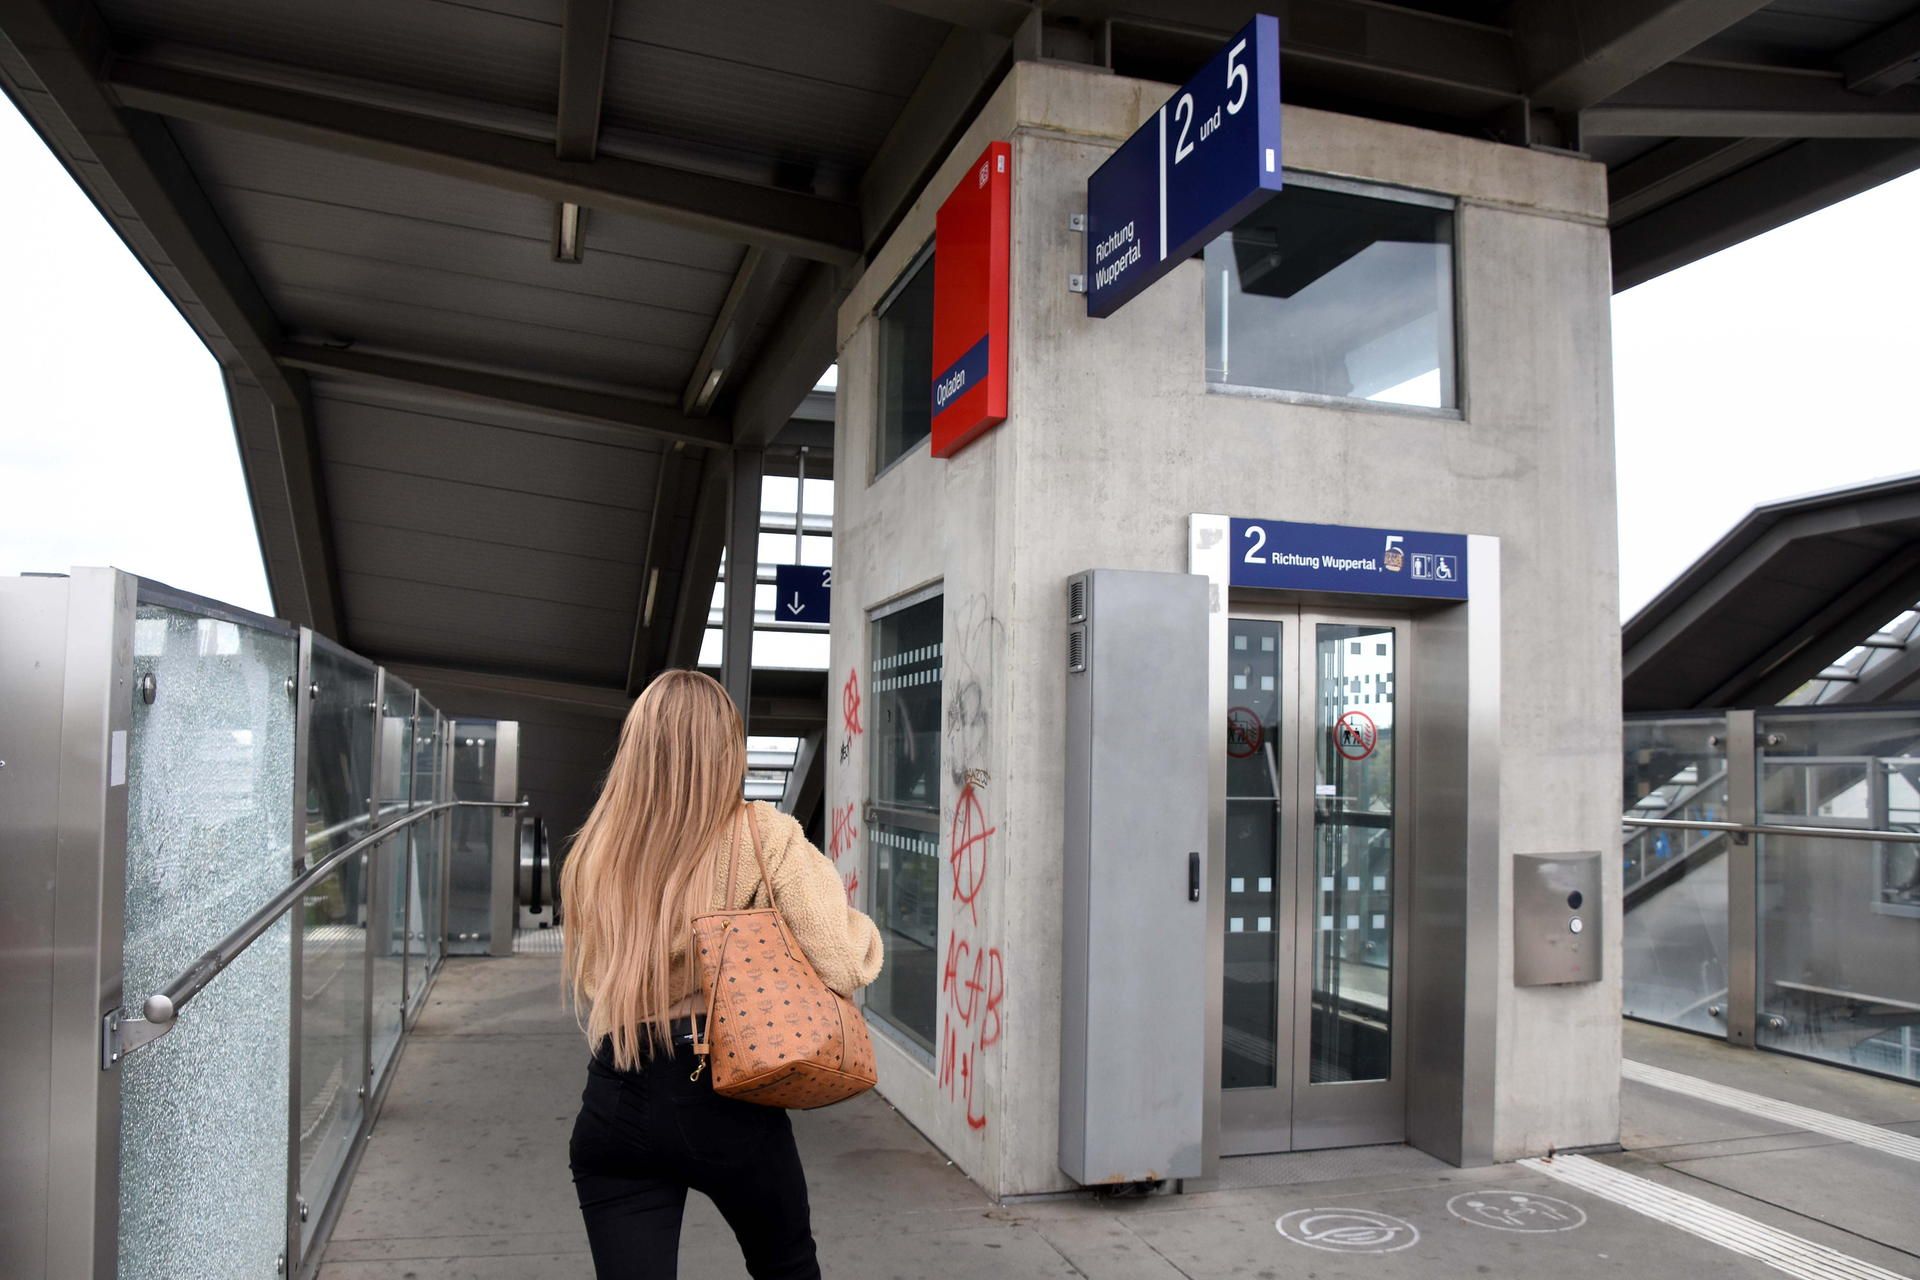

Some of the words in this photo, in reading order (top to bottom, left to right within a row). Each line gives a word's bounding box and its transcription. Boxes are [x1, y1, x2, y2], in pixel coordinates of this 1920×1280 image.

[1174, 92, 1195, 165] 2
[1199, 103, 1221, 142] und
[1226, 37, 1249, 116] 5
[1095, 238, 1142, 291] Wuppertal
[1096, 220, 1135, 265] Richtung
[936, 369, 966, 407] Opladen
[1244, 525, 1267, 564] 2
[1271, 552, 1320, 570] Richtung
